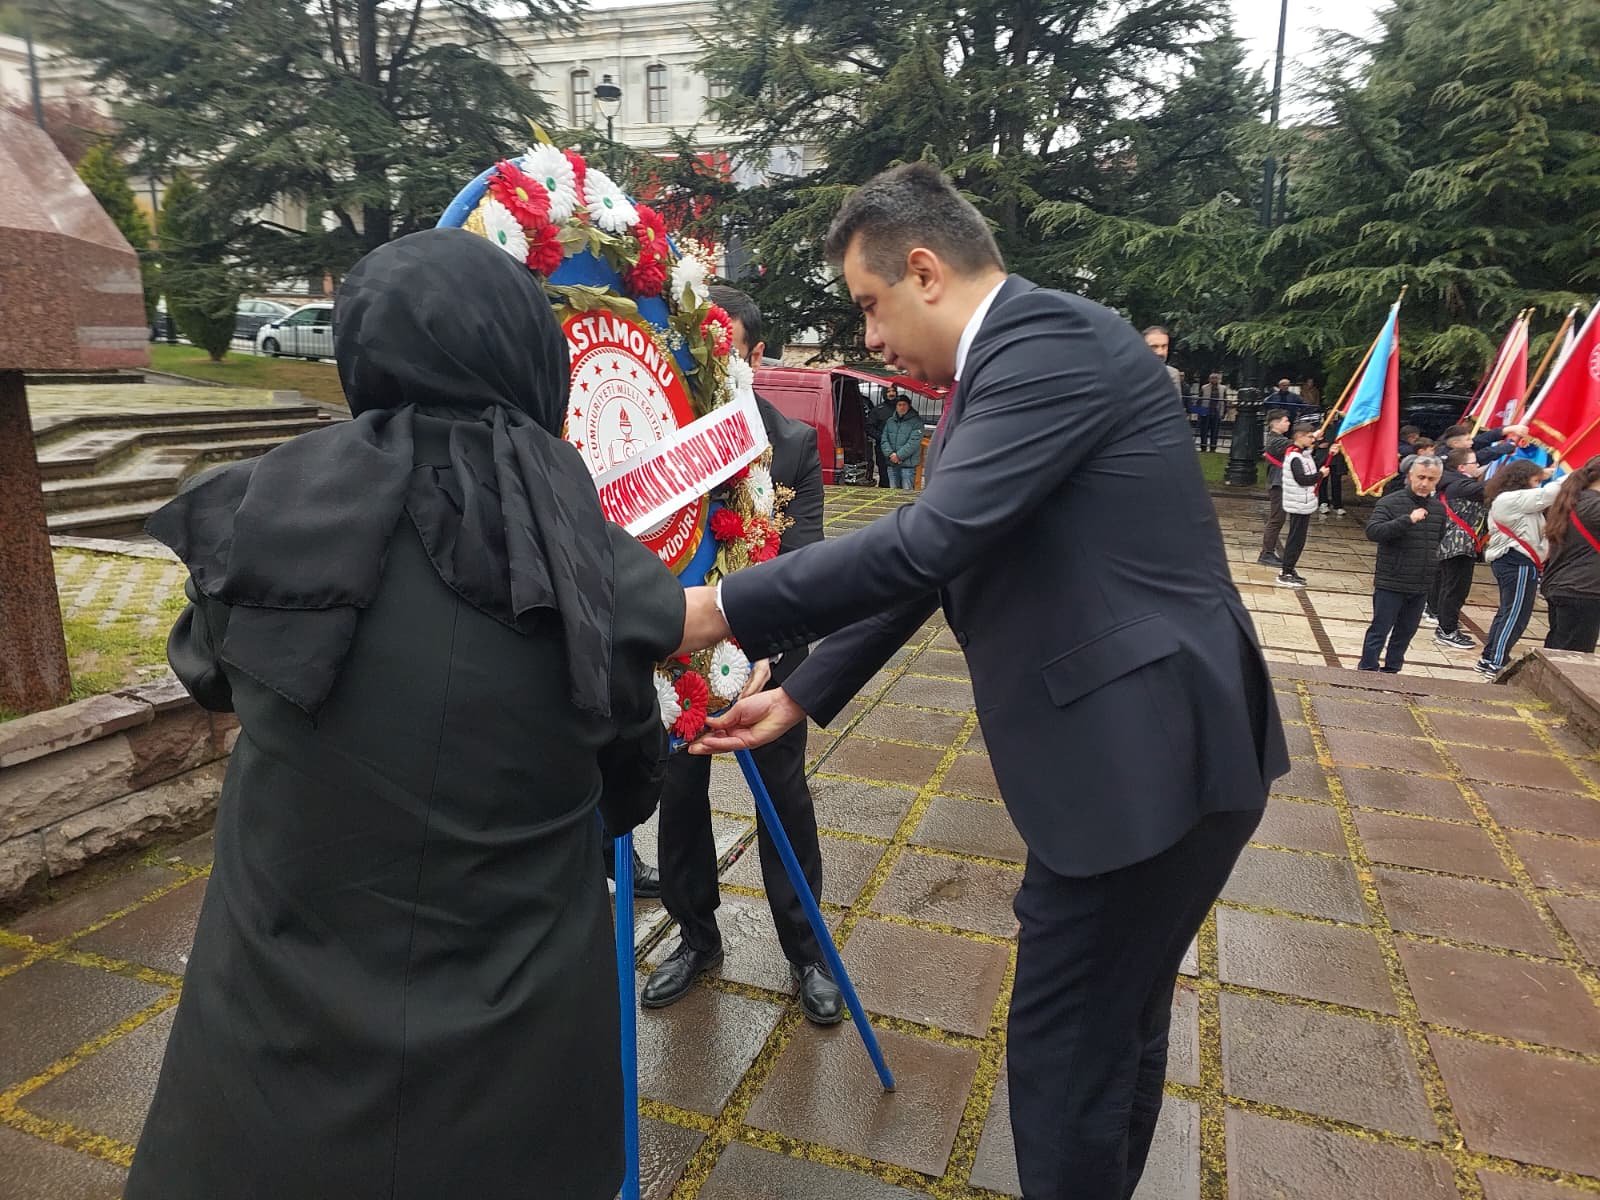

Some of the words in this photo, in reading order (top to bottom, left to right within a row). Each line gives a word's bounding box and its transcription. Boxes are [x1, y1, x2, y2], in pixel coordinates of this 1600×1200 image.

[567, 316, 674, 387] ASTAMONU
[655, 454, 686, 495] VE
[705, 409, 756, 467] BAYRAMI
[658, 499, 699, 562] MÜDÜRL
